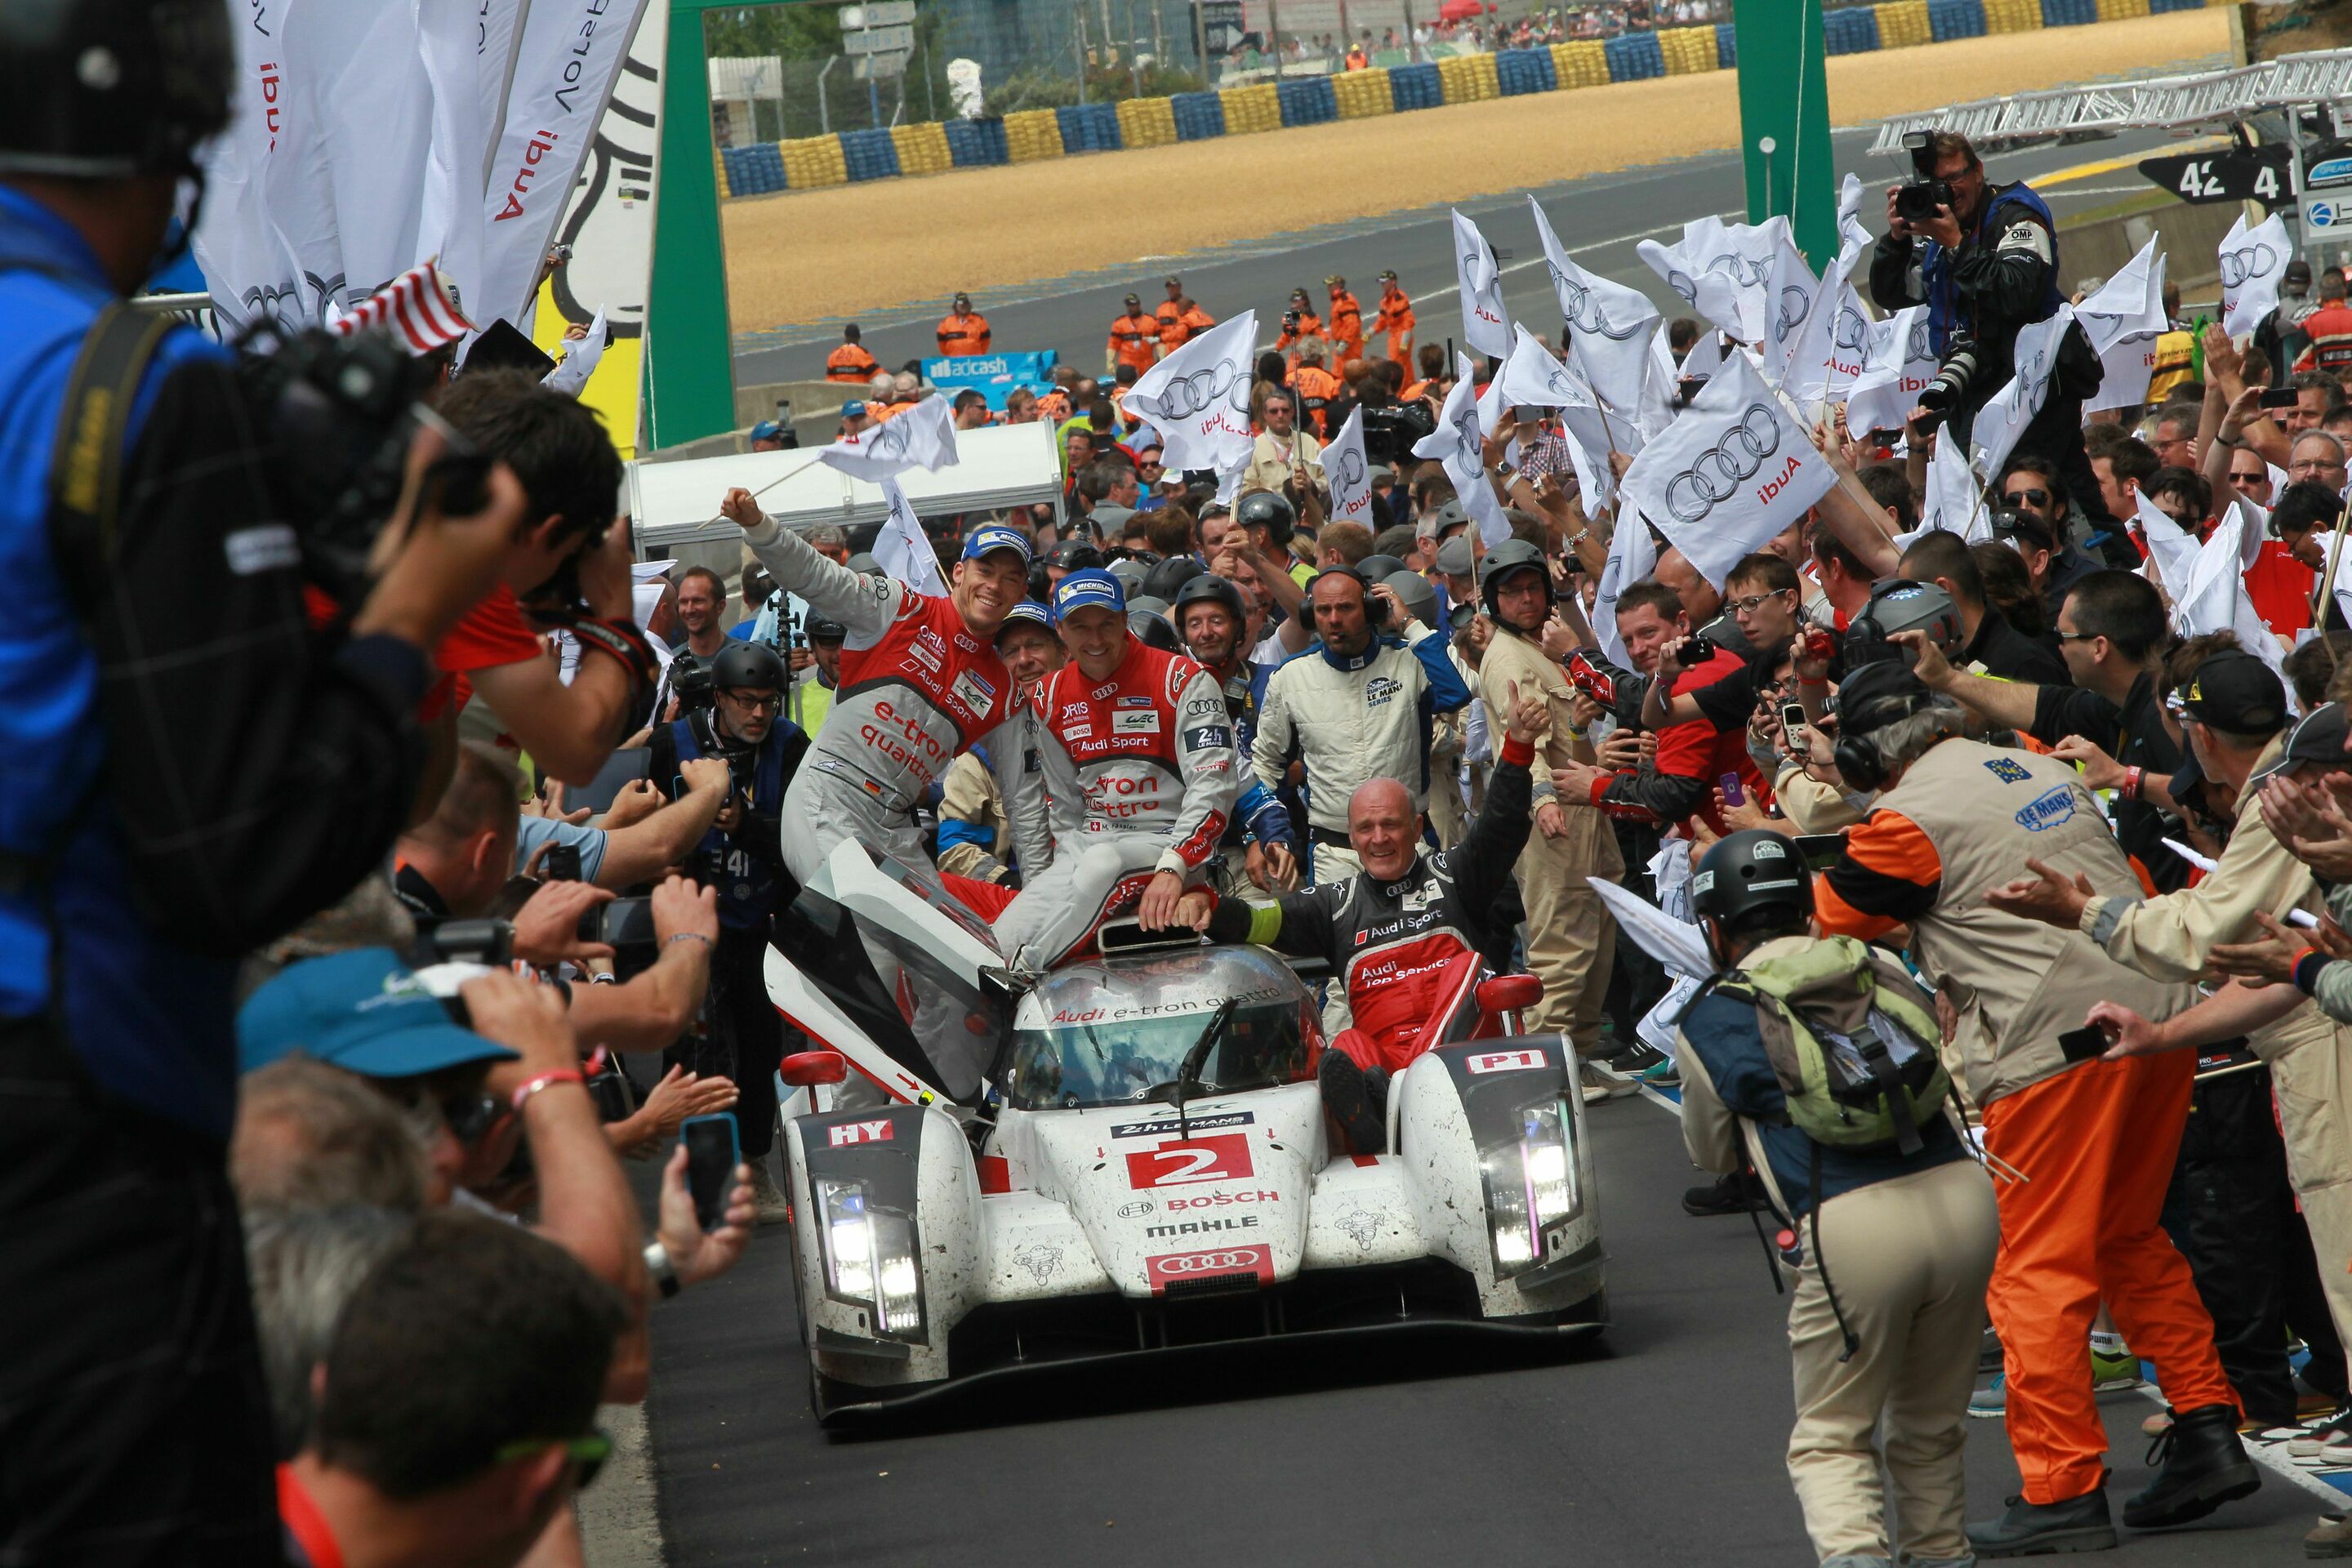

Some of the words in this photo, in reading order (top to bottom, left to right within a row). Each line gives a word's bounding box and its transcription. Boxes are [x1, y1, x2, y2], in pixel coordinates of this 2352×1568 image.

[2180, 161, 2225, 197] 42
[2011, 231, 2033, 239] OMP
[951, 357, 1007, 376] adcash
[917, 669, 943, 695] Audi
[945, 693, 972, 724] Sport
[1366, 679, 1399, 695] EUROPEAN
[1379, 682, 1404, 698] MANS
[1368, 695, 1392, 708] SERIES
[1080, 739, 1108, 751] Audi
[1111, 737, 1149, 749] Sport
[2020, 807, 2038, 825] LE
[2035, 790, 2073, 818] MANS
[1371, 919, 1404, 938] Audi
[1407, 908, 1443, 929] Sport
[1361, 960, 1398, 980] Audi
[1396, 958, 1451, 981] Service
[1052, 1009, 1106, 1023] Audi
[1113, 1000, 1198, 1019] e-tron
[1481, 1053, 1533, 1069] P1
[1189, 1116, 1245, 1128] MANS
[831, 1120, 889, 1146] HY
[1154, 1147, 1229, 1185] 2
[1167, 1191, 1280, 1211] BOSCH
[1147, 1215, 1258, 1238] MAHLE
